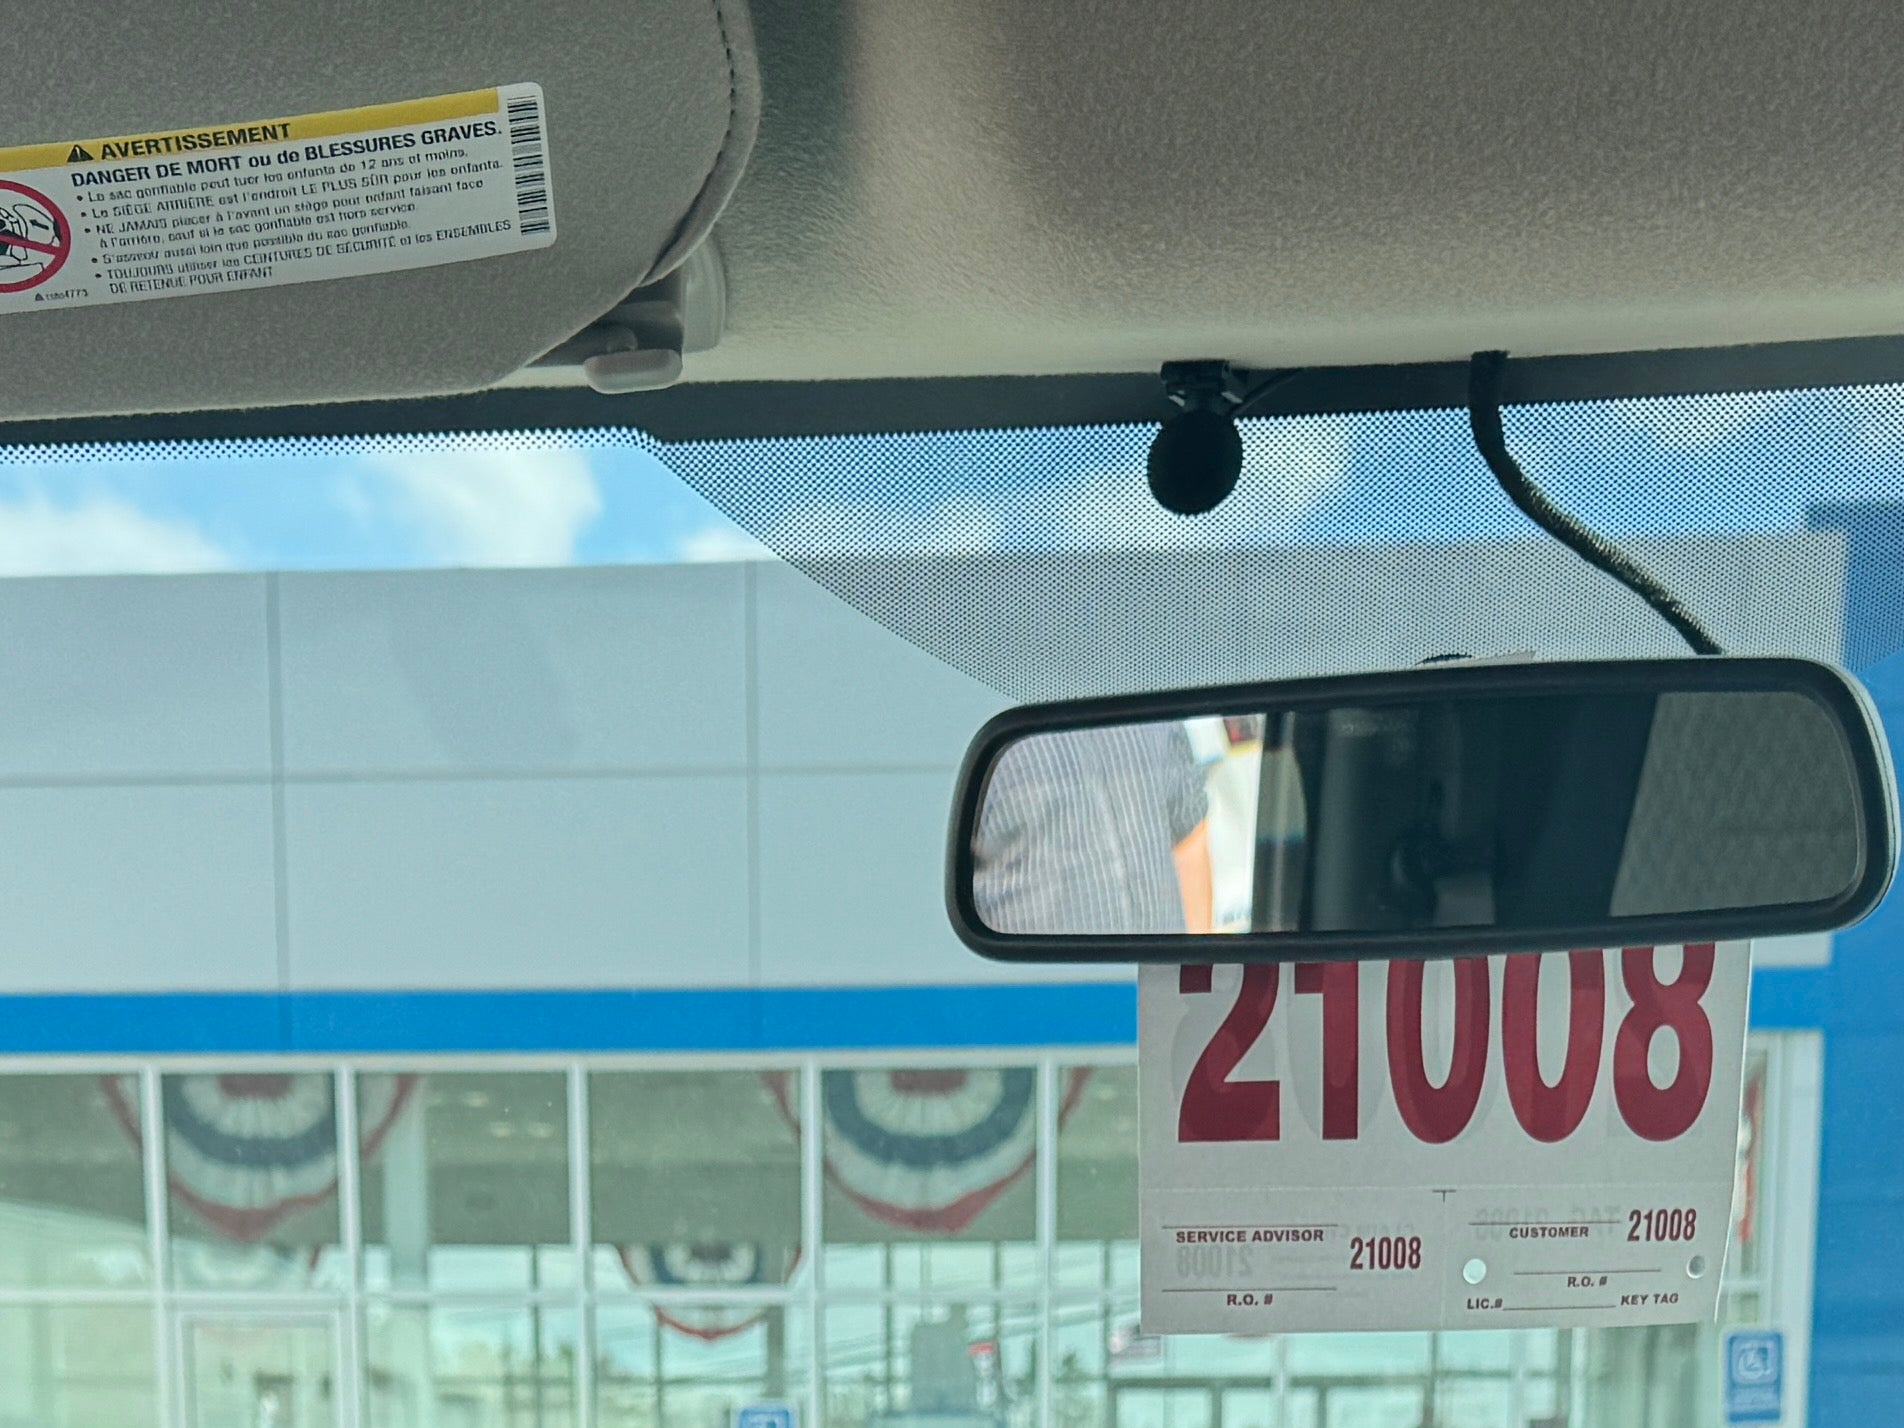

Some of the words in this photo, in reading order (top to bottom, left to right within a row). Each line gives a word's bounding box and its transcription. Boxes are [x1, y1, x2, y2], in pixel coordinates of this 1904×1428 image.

[71, 166, 151, 187] DANGER
[156, 162, 182, 179] DE
[187, 156, 242, 175] MORT
[248, 154, 271, 168] ou
[277, 150, 300, 164] de
[305, 133, 416, 161] BLESSURES
[421, 120, 502, 146] GRAVES.
[100, 123, 291, 160] AVERTISSEMENT
[1178, 940, 1716, 1144] 21008
[1509, 1226, 1590, 1240] CUSTOMER
[1627, 1208, 1697, 1242] 21008
[1176, 1229, 1245, 1244] SERVICE
[1251, 1228, 1324, 1243] ADVISOR
[1349, 1236, 1422, 1270] 21008
[1566, 1275, 1594, 1288] R.O.
[1598, 1275, 1608, 1287] #
[1226, 1293, 1259, 1307] R.O.
[1263, 1293, 1274, 1306] #
[1621, 1294, 1648, 1307] KEY
[1651, 1292, 1679, 1305] TAG
